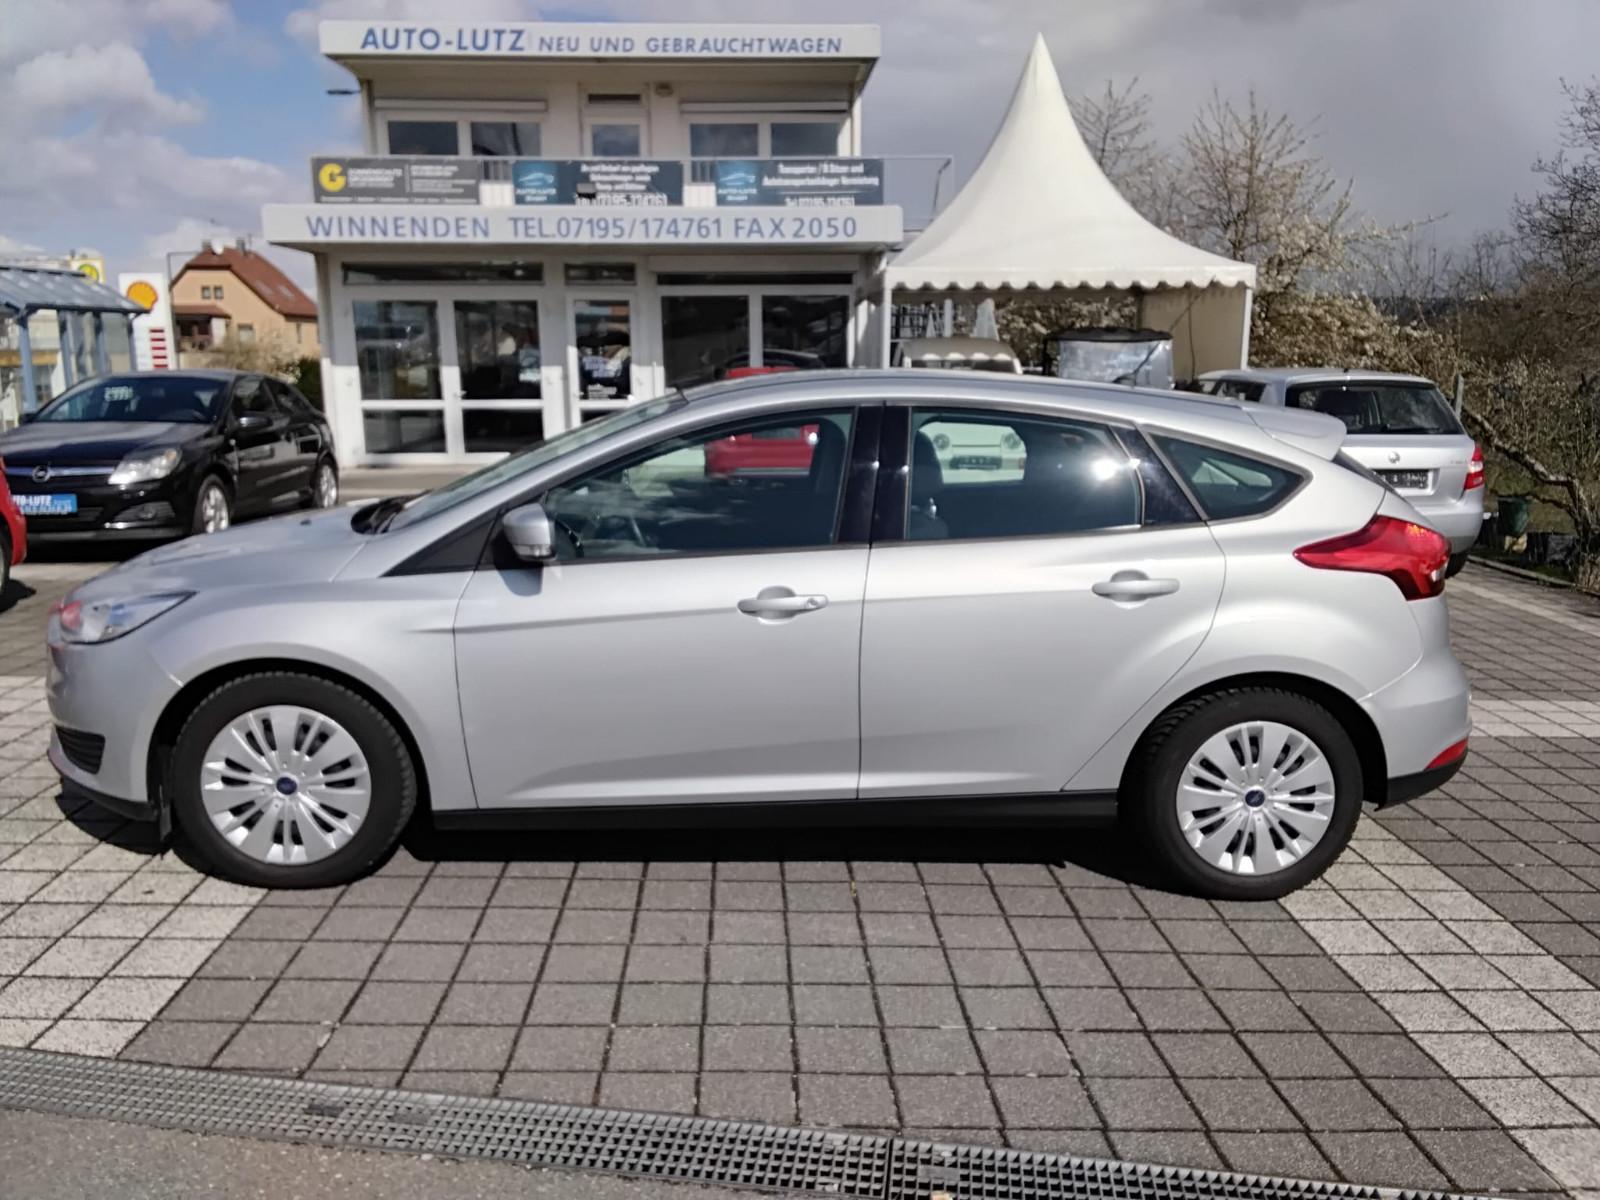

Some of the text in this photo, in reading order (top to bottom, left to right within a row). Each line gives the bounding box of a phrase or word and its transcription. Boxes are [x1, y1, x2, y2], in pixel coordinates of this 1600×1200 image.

[361, 28, 842, 53] AUTO-LUTZ NEU UND GEBRAUCHTWAGEN
[306, 216, 489, 238] WINNENDEN
[733, 217, 786, 239] FAX
[791, 217, 857, 239] 2050
